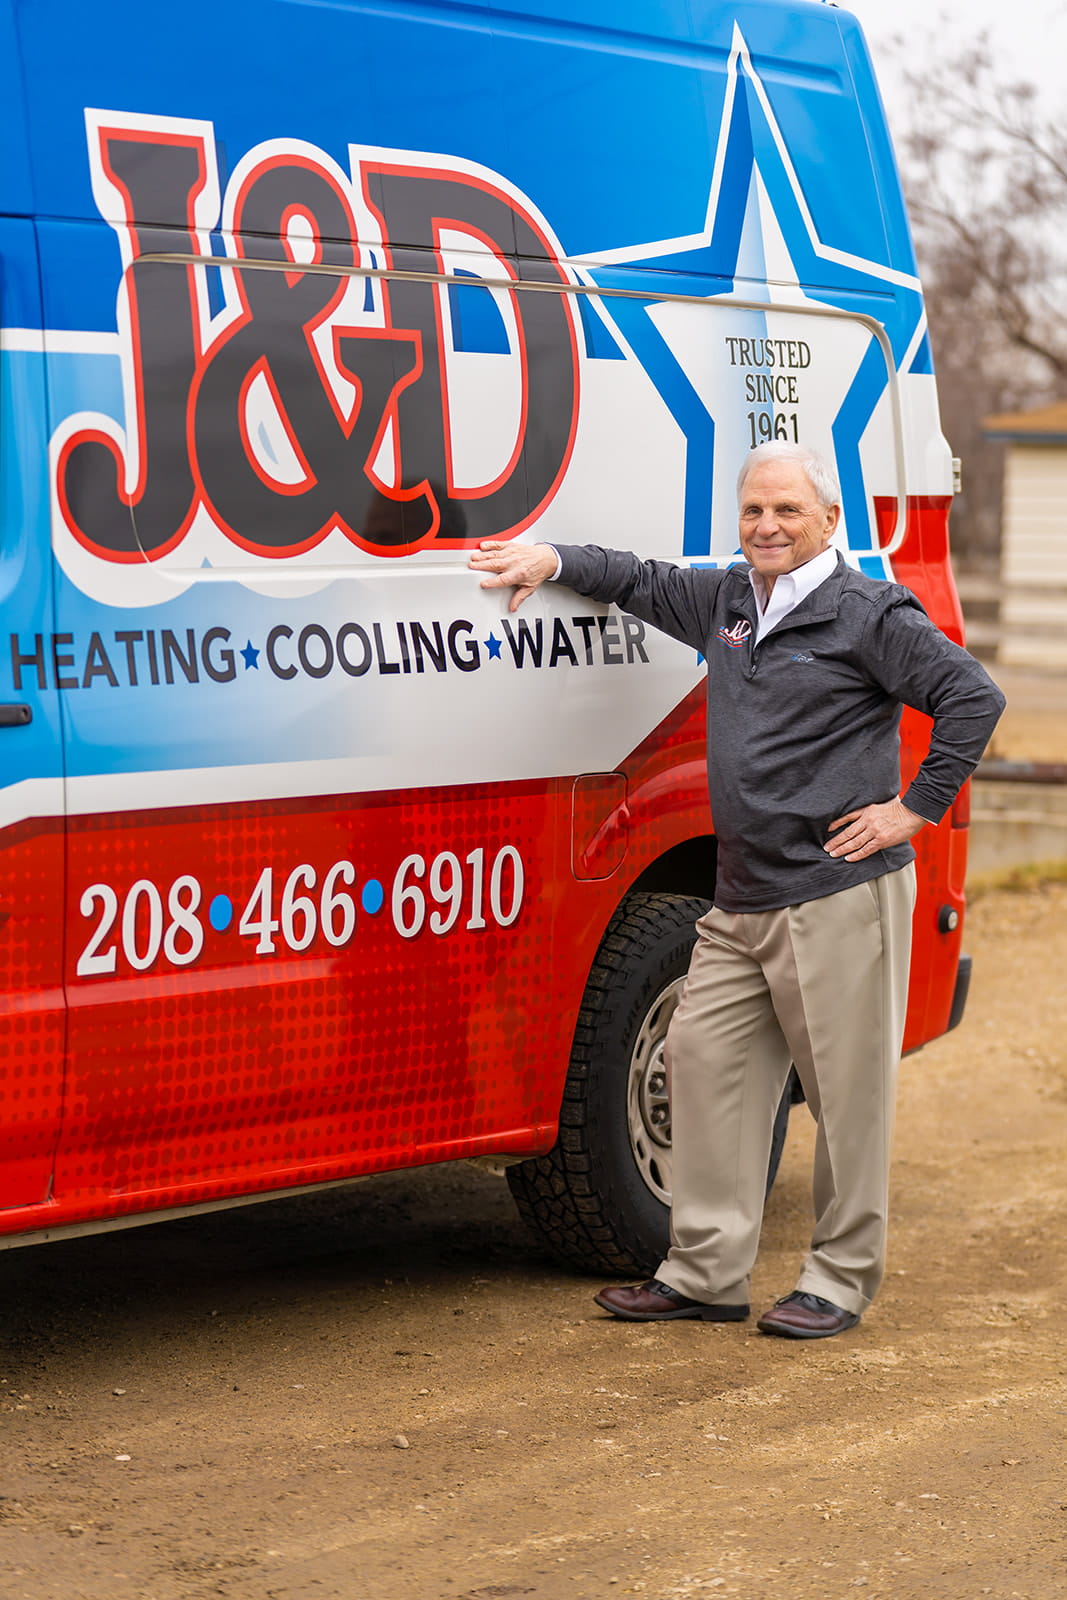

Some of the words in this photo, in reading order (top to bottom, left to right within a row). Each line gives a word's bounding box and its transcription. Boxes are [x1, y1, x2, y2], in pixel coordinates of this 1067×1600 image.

[56, 125, 580, 565] J&D
[725, 337, 811, 369] TRUSTED
[745, 374, 799, 404] SINCE
[747, 411, 799, 450] 1961
[10, 626, 237, 691] HEATING
[265, 619, 481, 681] COOLING
[500, 615, 650, 670] WATER
[76, 874, 204, 977] 208
[238, 859, 356, 955] 466
[391, 844, 525, 939] 6910
